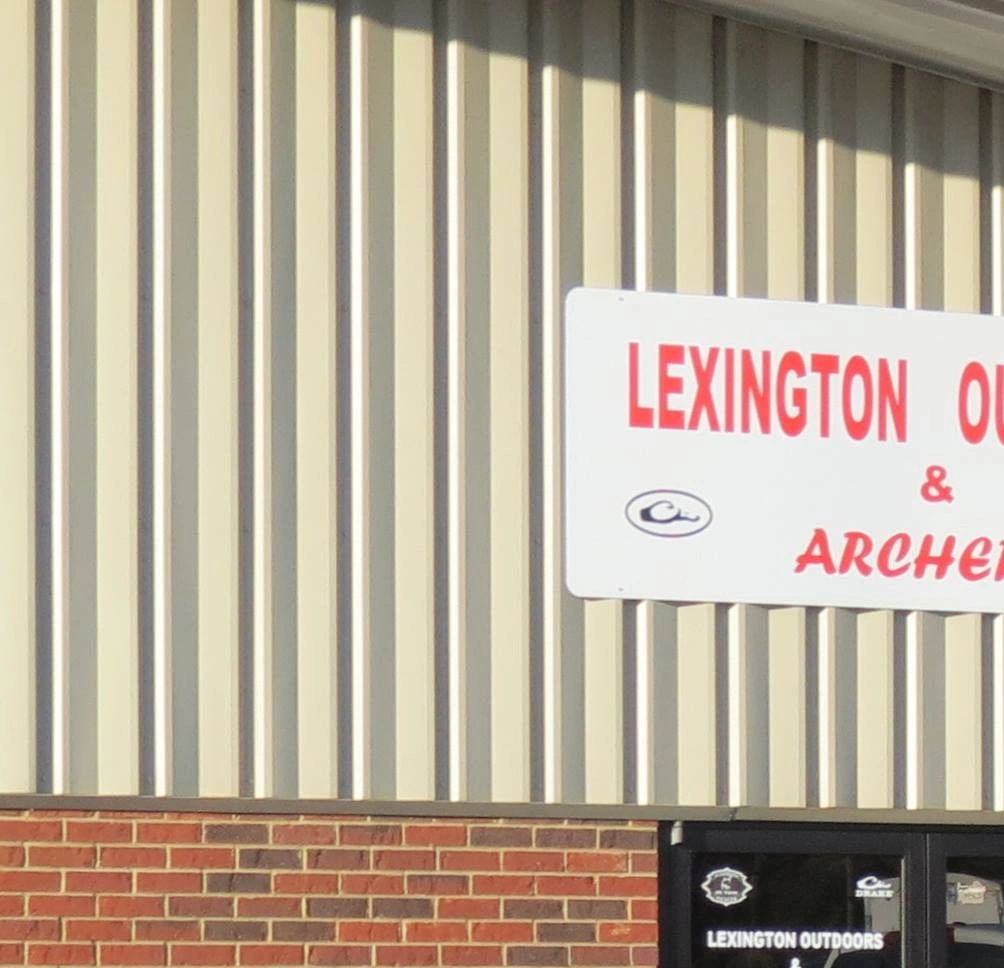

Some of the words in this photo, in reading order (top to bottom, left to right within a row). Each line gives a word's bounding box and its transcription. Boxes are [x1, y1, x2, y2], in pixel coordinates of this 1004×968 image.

[628, 341, 908, 443] LEXINGTON
[920, 465, 954, 503] &
[707, 930, 797, 949] LEXINGTON
[798, 931, 885, 950] OUTDOORS
